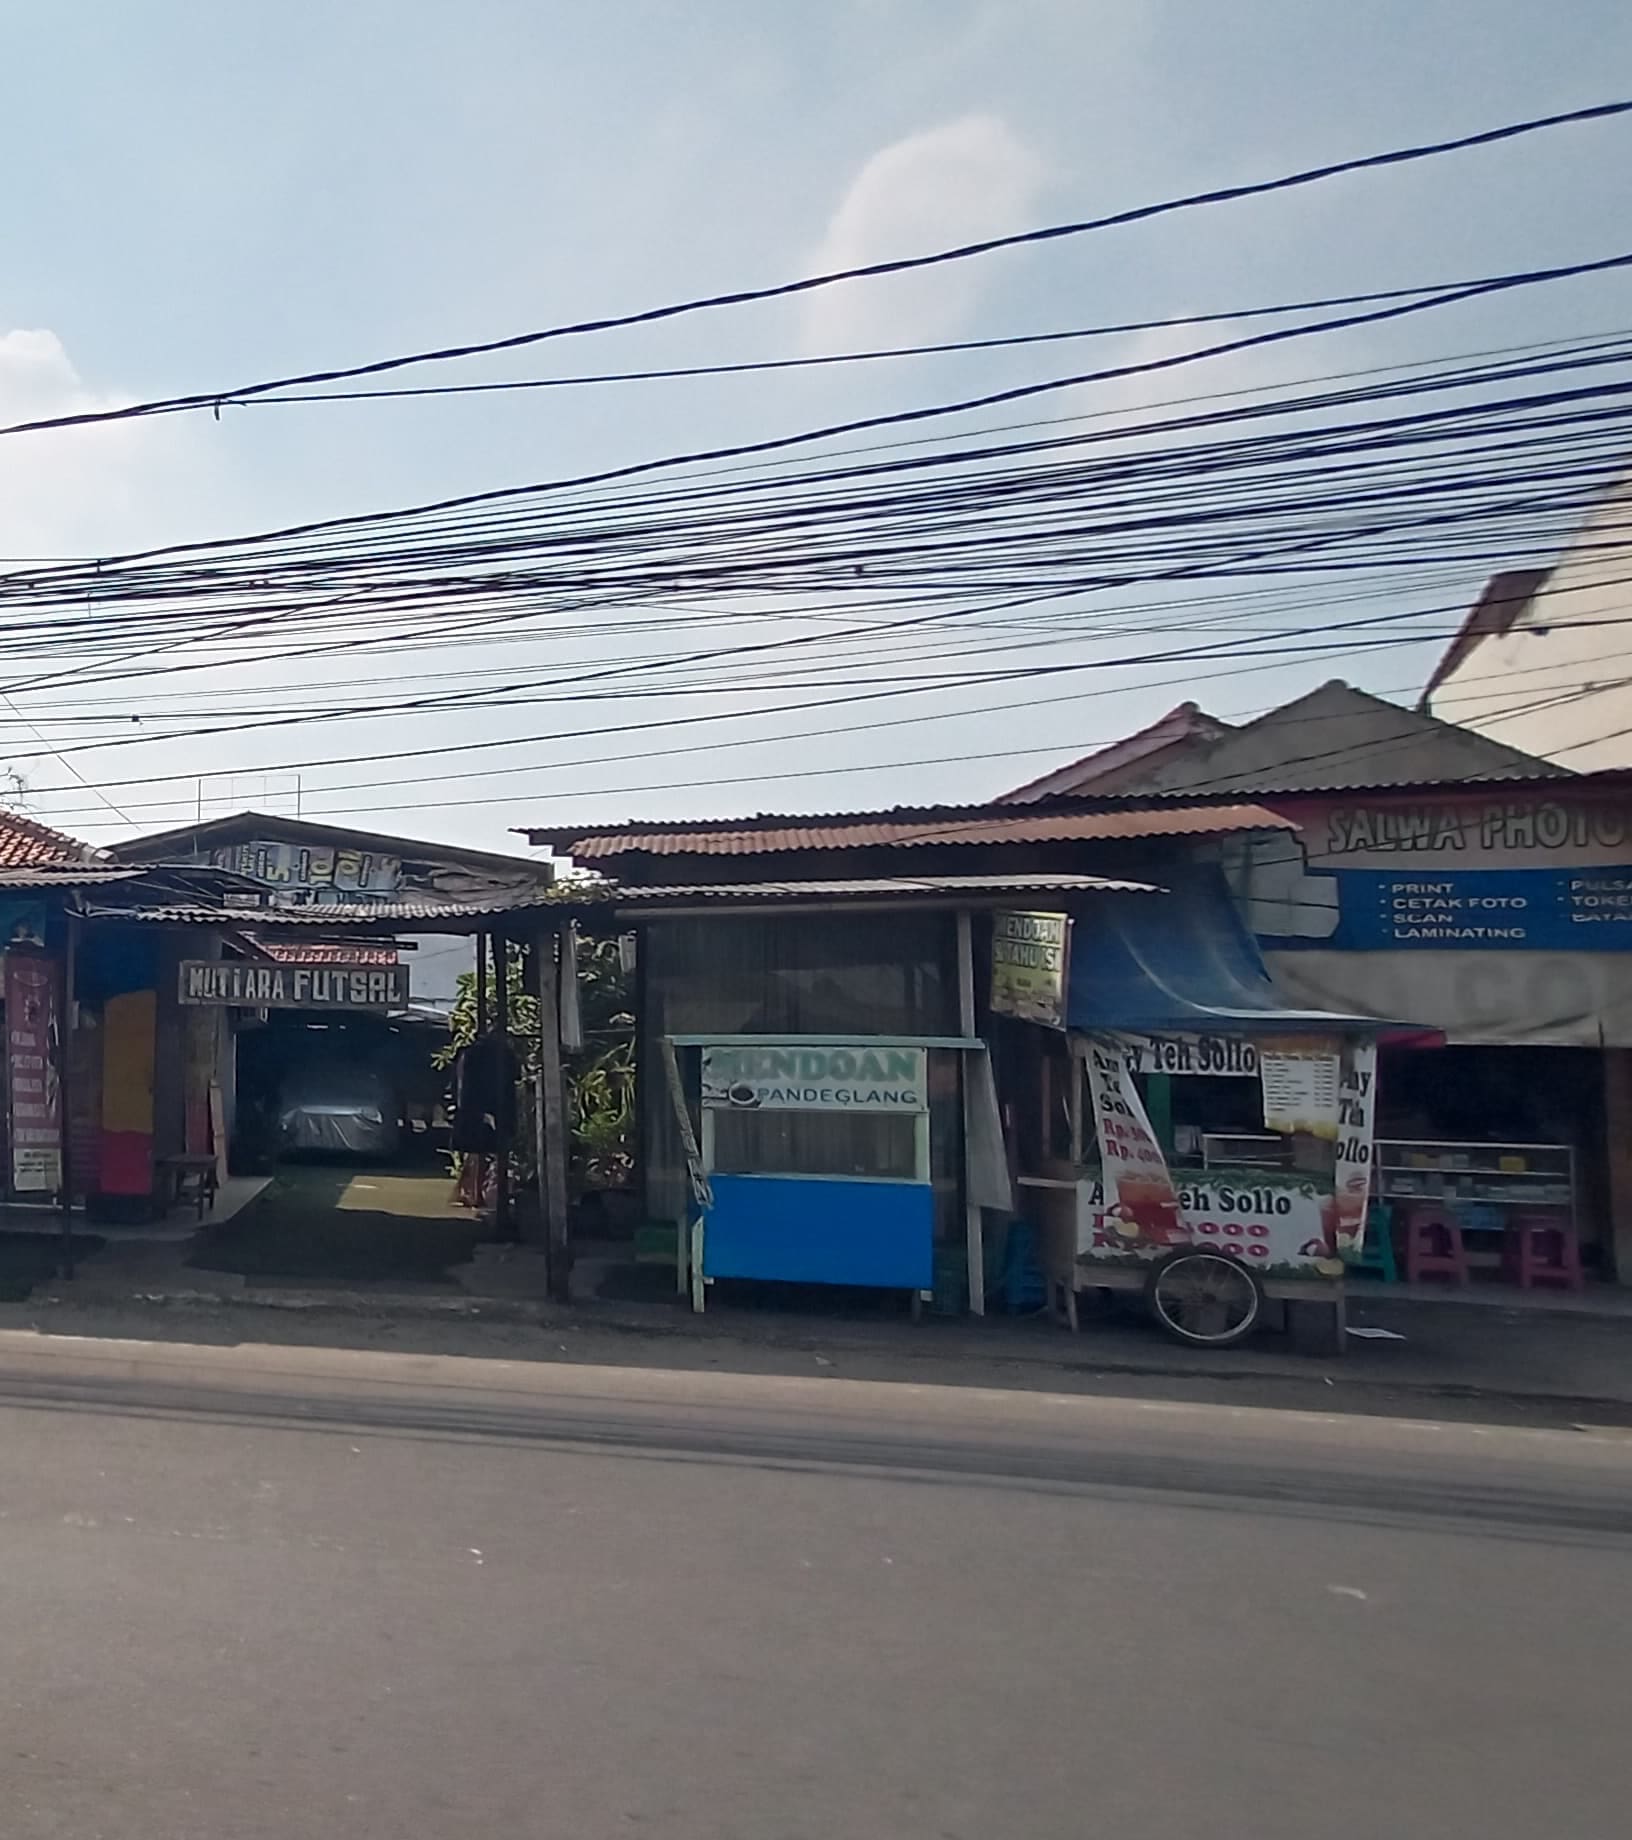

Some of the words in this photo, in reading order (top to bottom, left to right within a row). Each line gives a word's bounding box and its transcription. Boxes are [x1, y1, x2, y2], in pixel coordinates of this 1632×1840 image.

[1328, 808, 1465, 851] SALWA
[1481, 803, 1626, 850] PHOTO
[1391, 882, 1455, 894] PRINT
[1392, 897, 1463, 910] CETAK
[1469, 897, 1528, 909] FOTO
[1570, 895, 1632, 907] TOKE
[1393, 913, 1454, 924] SCAN
[1394, 927, 1527, 939] LAMINATING
[293, 968, 402, 1004] FUTSAL
[1149, 1037, 1192, 1071] Teh
[1197, 1037, 1257, 1072] Sollo
[756, 1087, 918, 1104] PANDEGLANG
[1335, 1136, 1370, 1164] ollo
[1179, 1186, 1210, 1211] eh
[1218, 1186, 1292, 1215] Sollo
